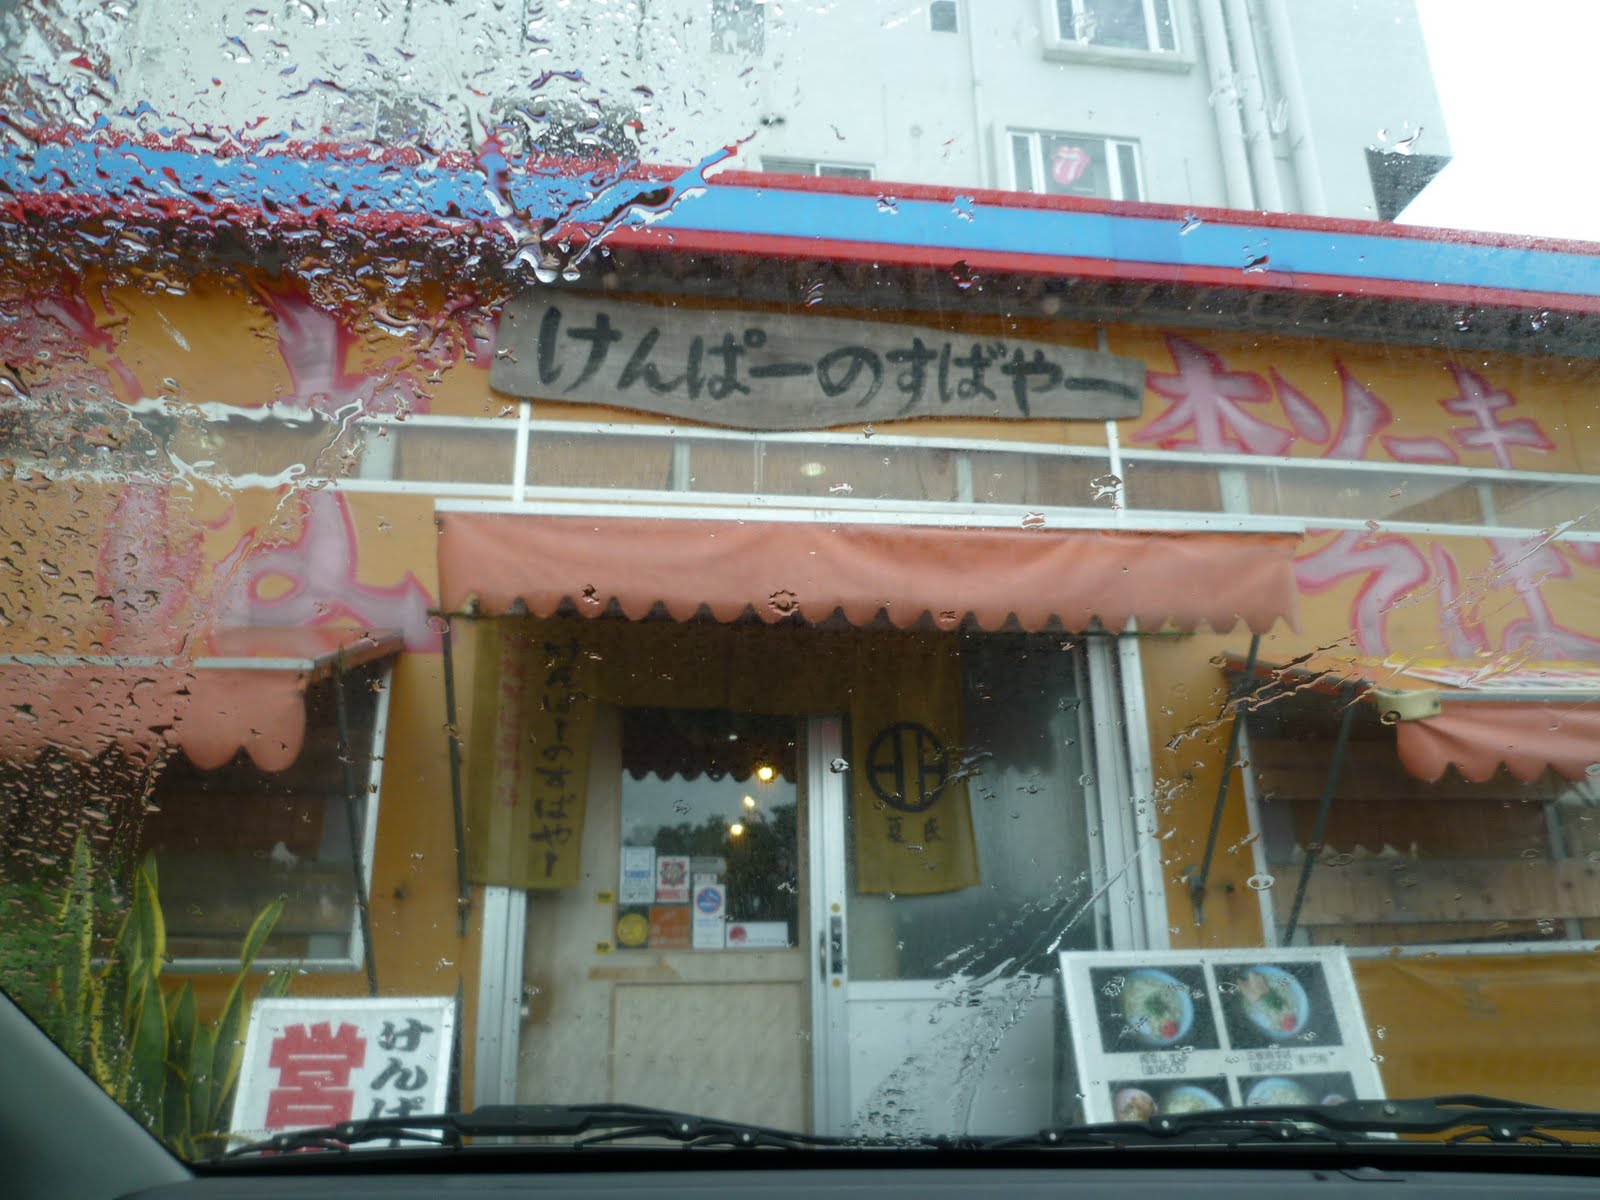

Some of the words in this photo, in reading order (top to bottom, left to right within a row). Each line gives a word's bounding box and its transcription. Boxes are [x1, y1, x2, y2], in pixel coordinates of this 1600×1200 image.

[535, 305, 1142, 416] けんぱーのすばやー
[261, 1021, 368, 1155] 営
[367, 1018, 434, 1148] けんぱ
